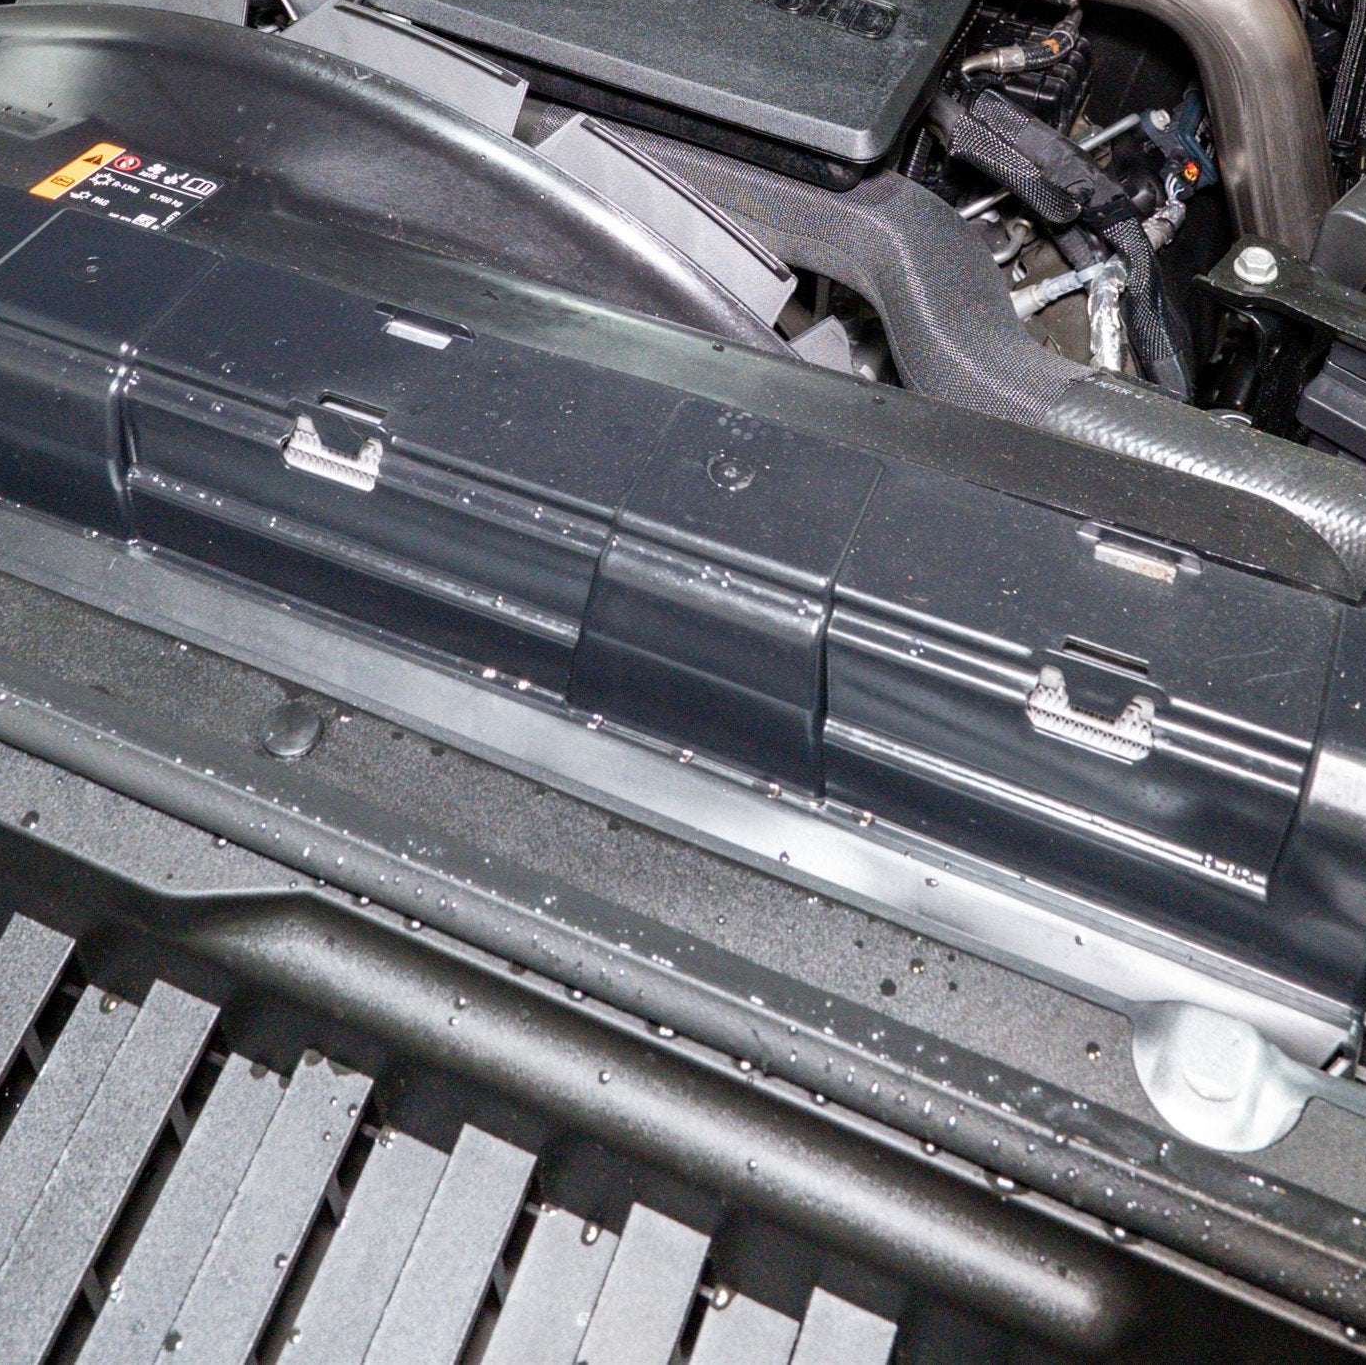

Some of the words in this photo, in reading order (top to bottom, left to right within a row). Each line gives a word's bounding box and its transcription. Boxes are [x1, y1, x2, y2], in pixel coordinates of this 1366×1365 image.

[138, 170, 159, 180] AUTO
[111, 180, 141, 194] R-134a
[171, 197, 184, 209] kg
[91, 196, 111, 207] PAG
